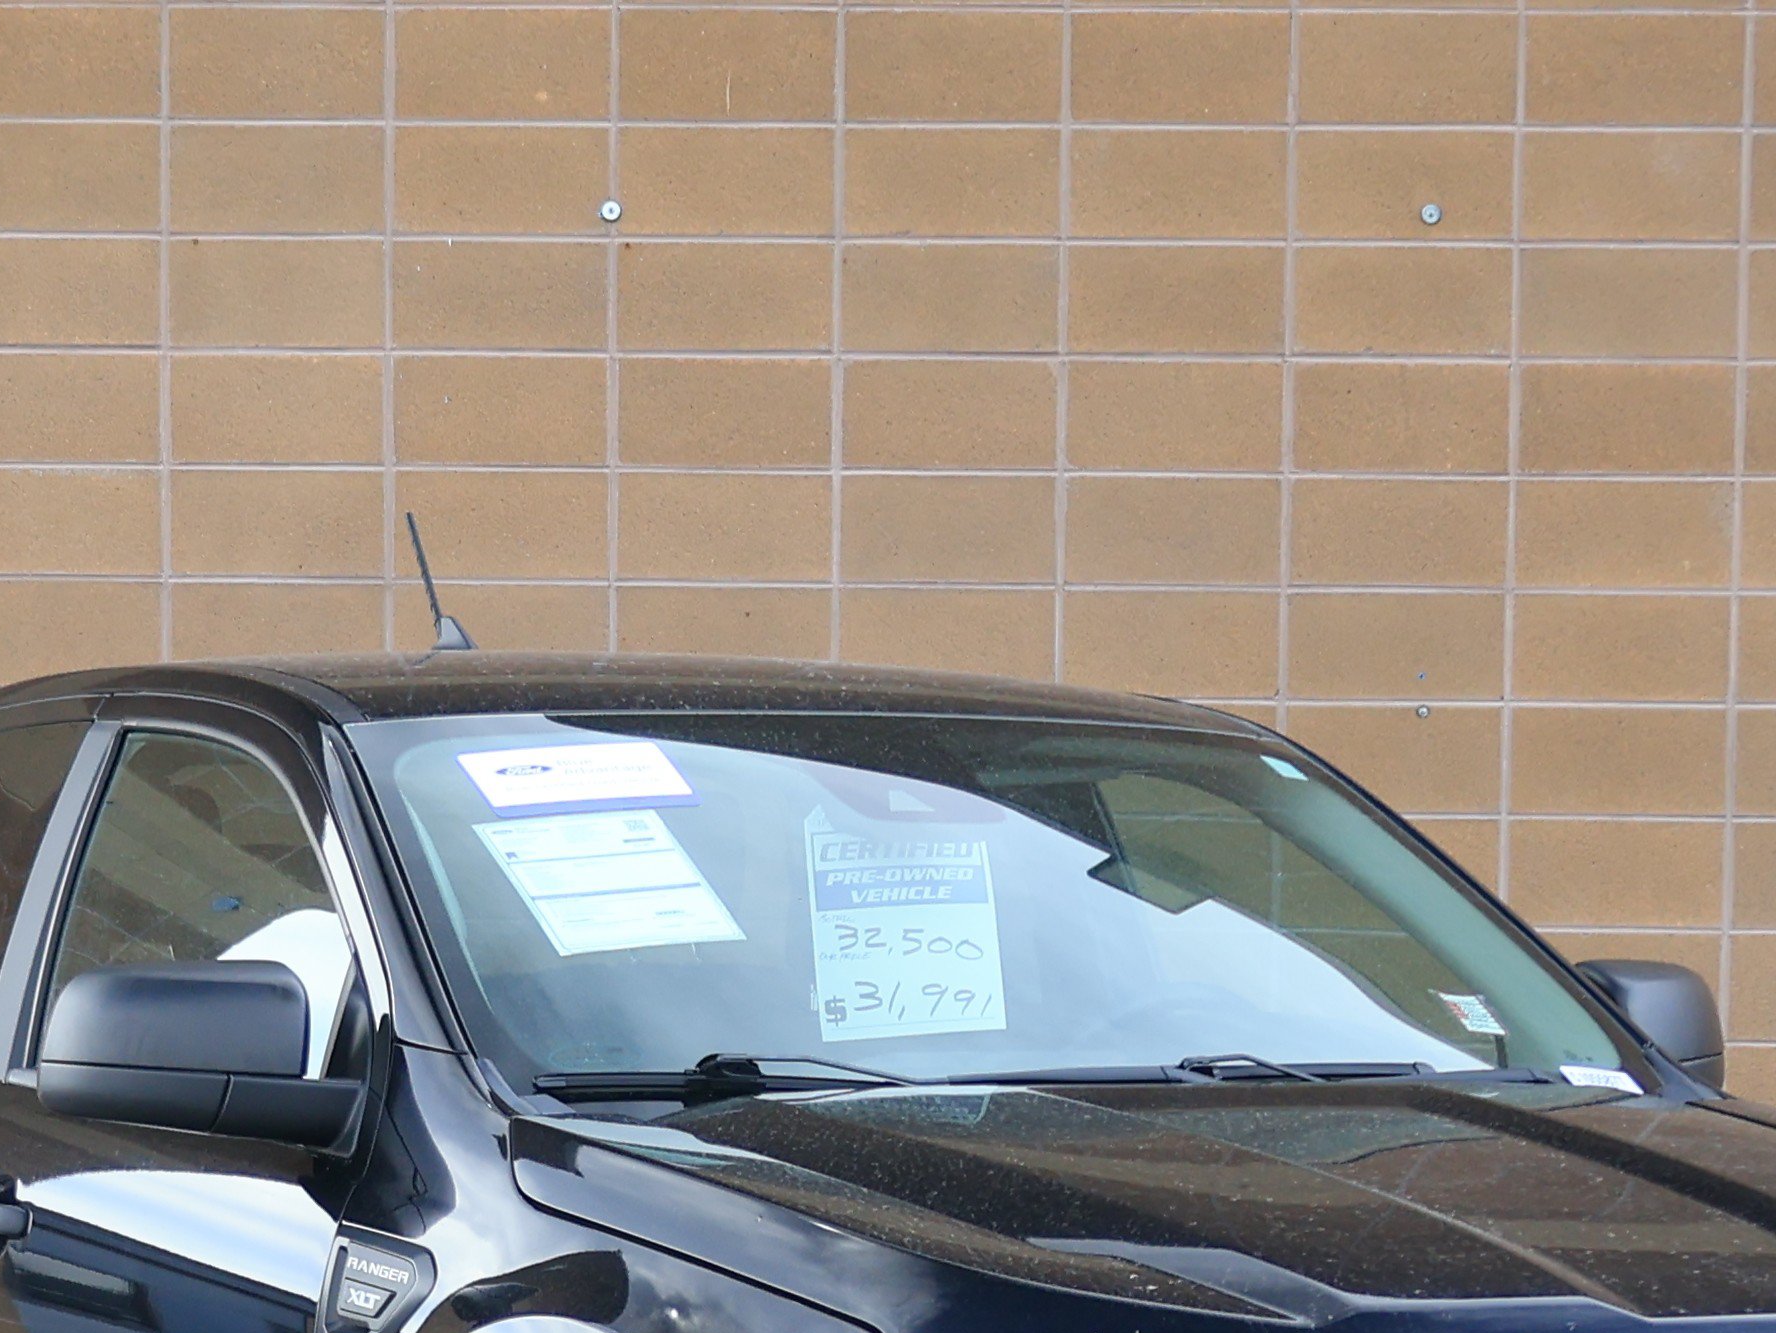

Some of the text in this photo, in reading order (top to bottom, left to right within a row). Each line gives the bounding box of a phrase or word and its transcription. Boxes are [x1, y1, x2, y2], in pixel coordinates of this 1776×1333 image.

[826, 867, 974, 886] PRE-OWNED
[851, 886, 952, 903] VEHICLE
[834, 924, 984, 961] 32,500
[347, 1256, 409, 1284] RANGER
[346, 1287, 381, 1309] XLT
